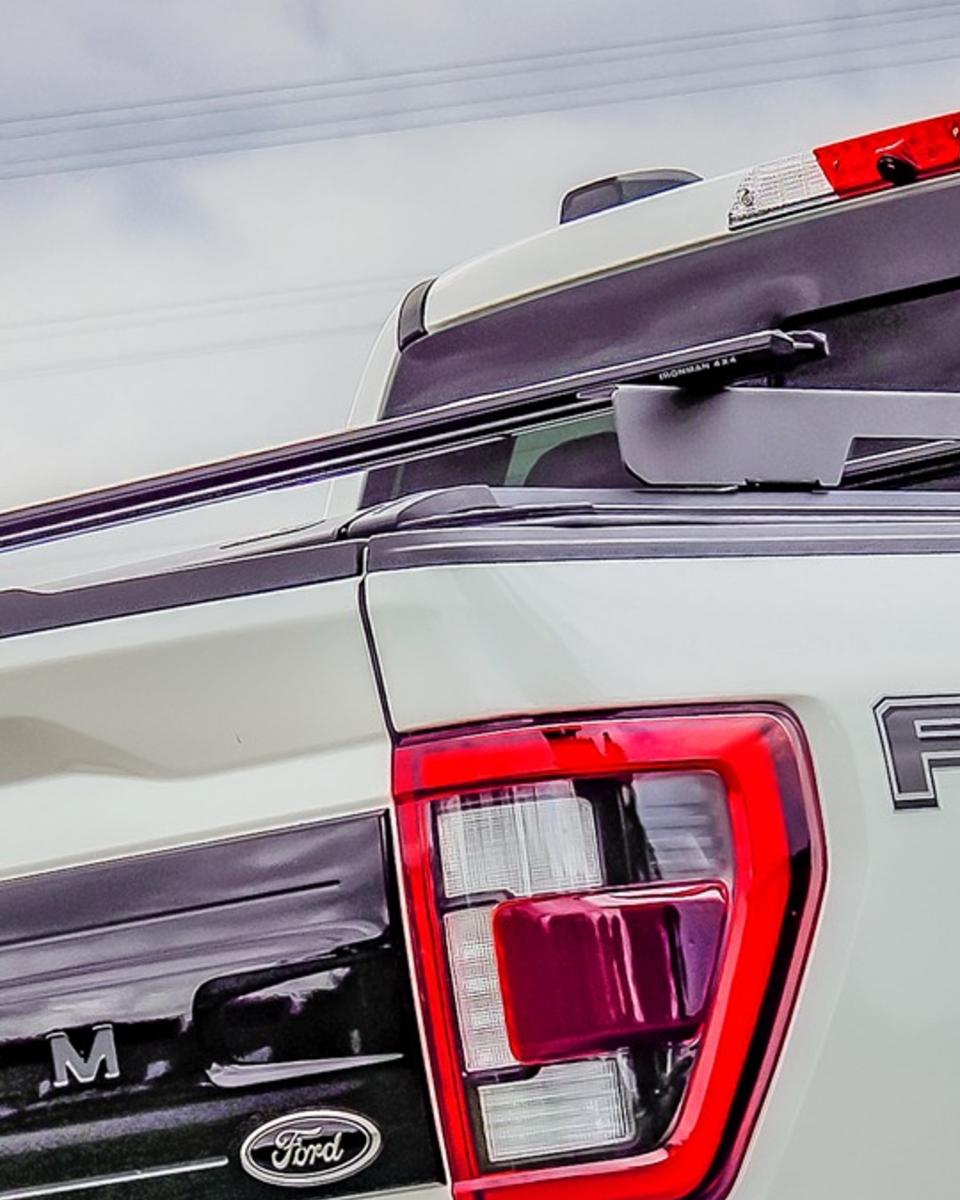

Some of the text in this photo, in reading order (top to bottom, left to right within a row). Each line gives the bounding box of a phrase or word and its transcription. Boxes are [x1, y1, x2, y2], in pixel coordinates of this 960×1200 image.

[658, 362, 710, 381] IRONMAN
[46, 1023, 121, 1088] M
[271, 1126, 345, 1170] Ford
